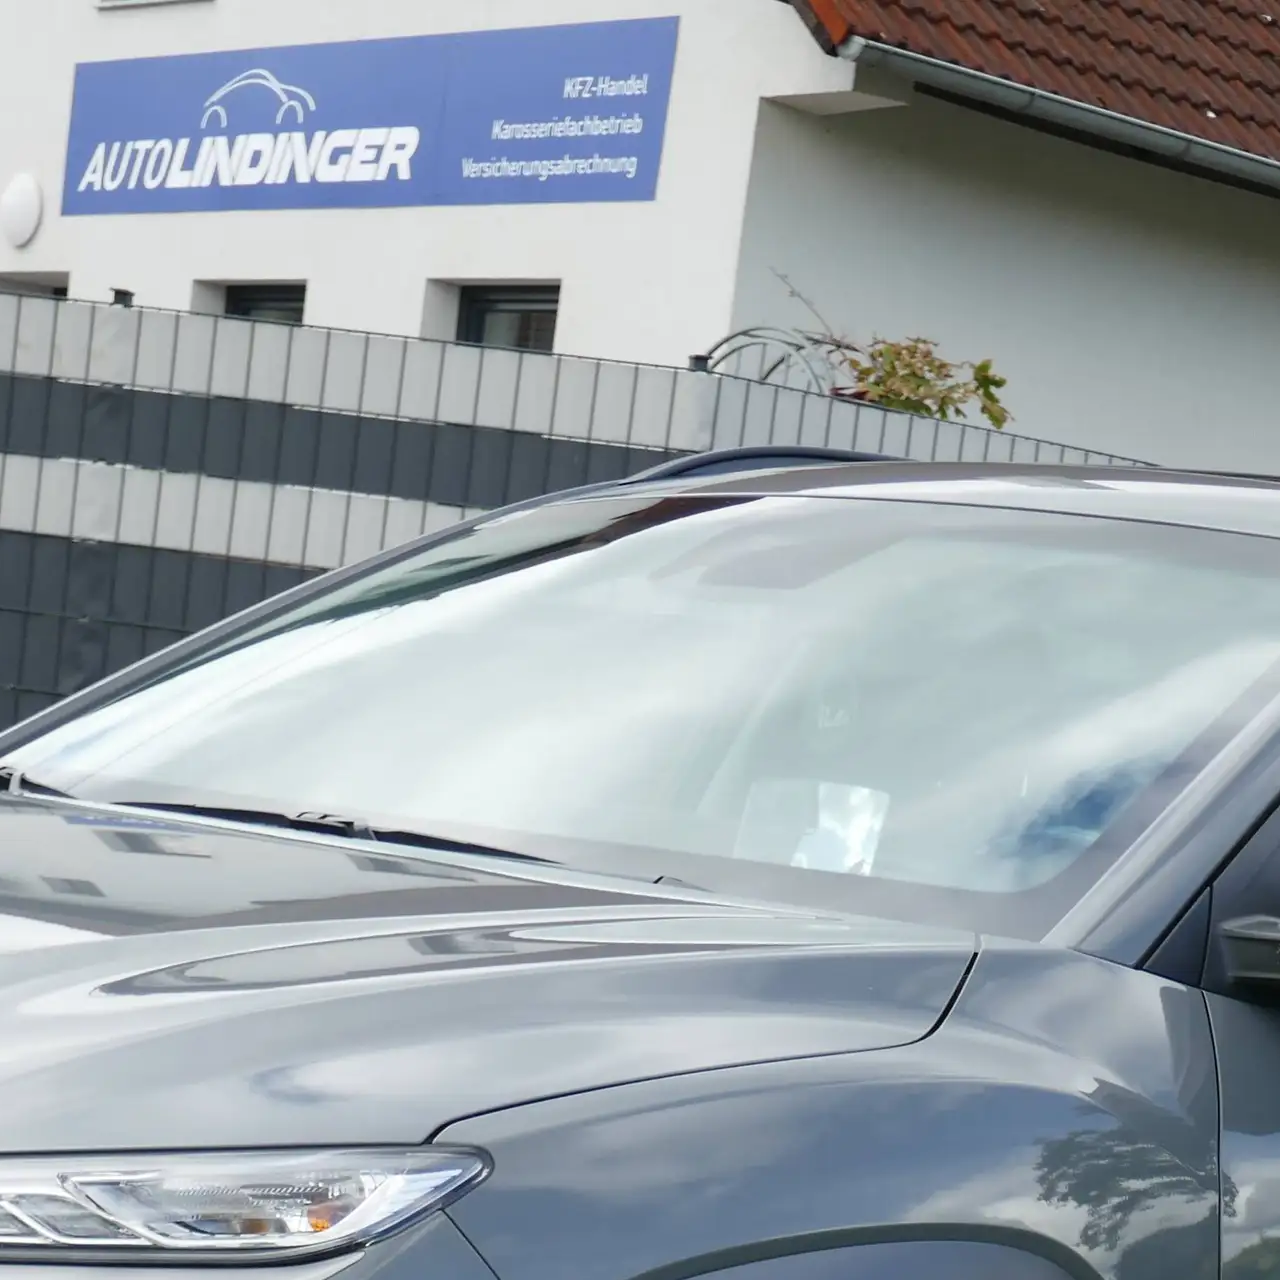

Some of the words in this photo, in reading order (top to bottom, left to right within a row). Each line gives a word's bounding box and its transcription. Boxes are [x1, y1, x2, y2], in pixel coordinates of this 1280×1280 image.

[563, 74, 649, 98] KFZ-Handel
[491, 113, 643, 139] Karosseriefachbetrieb
[462, 154, 638, 181] Versicherungsabrechnung
